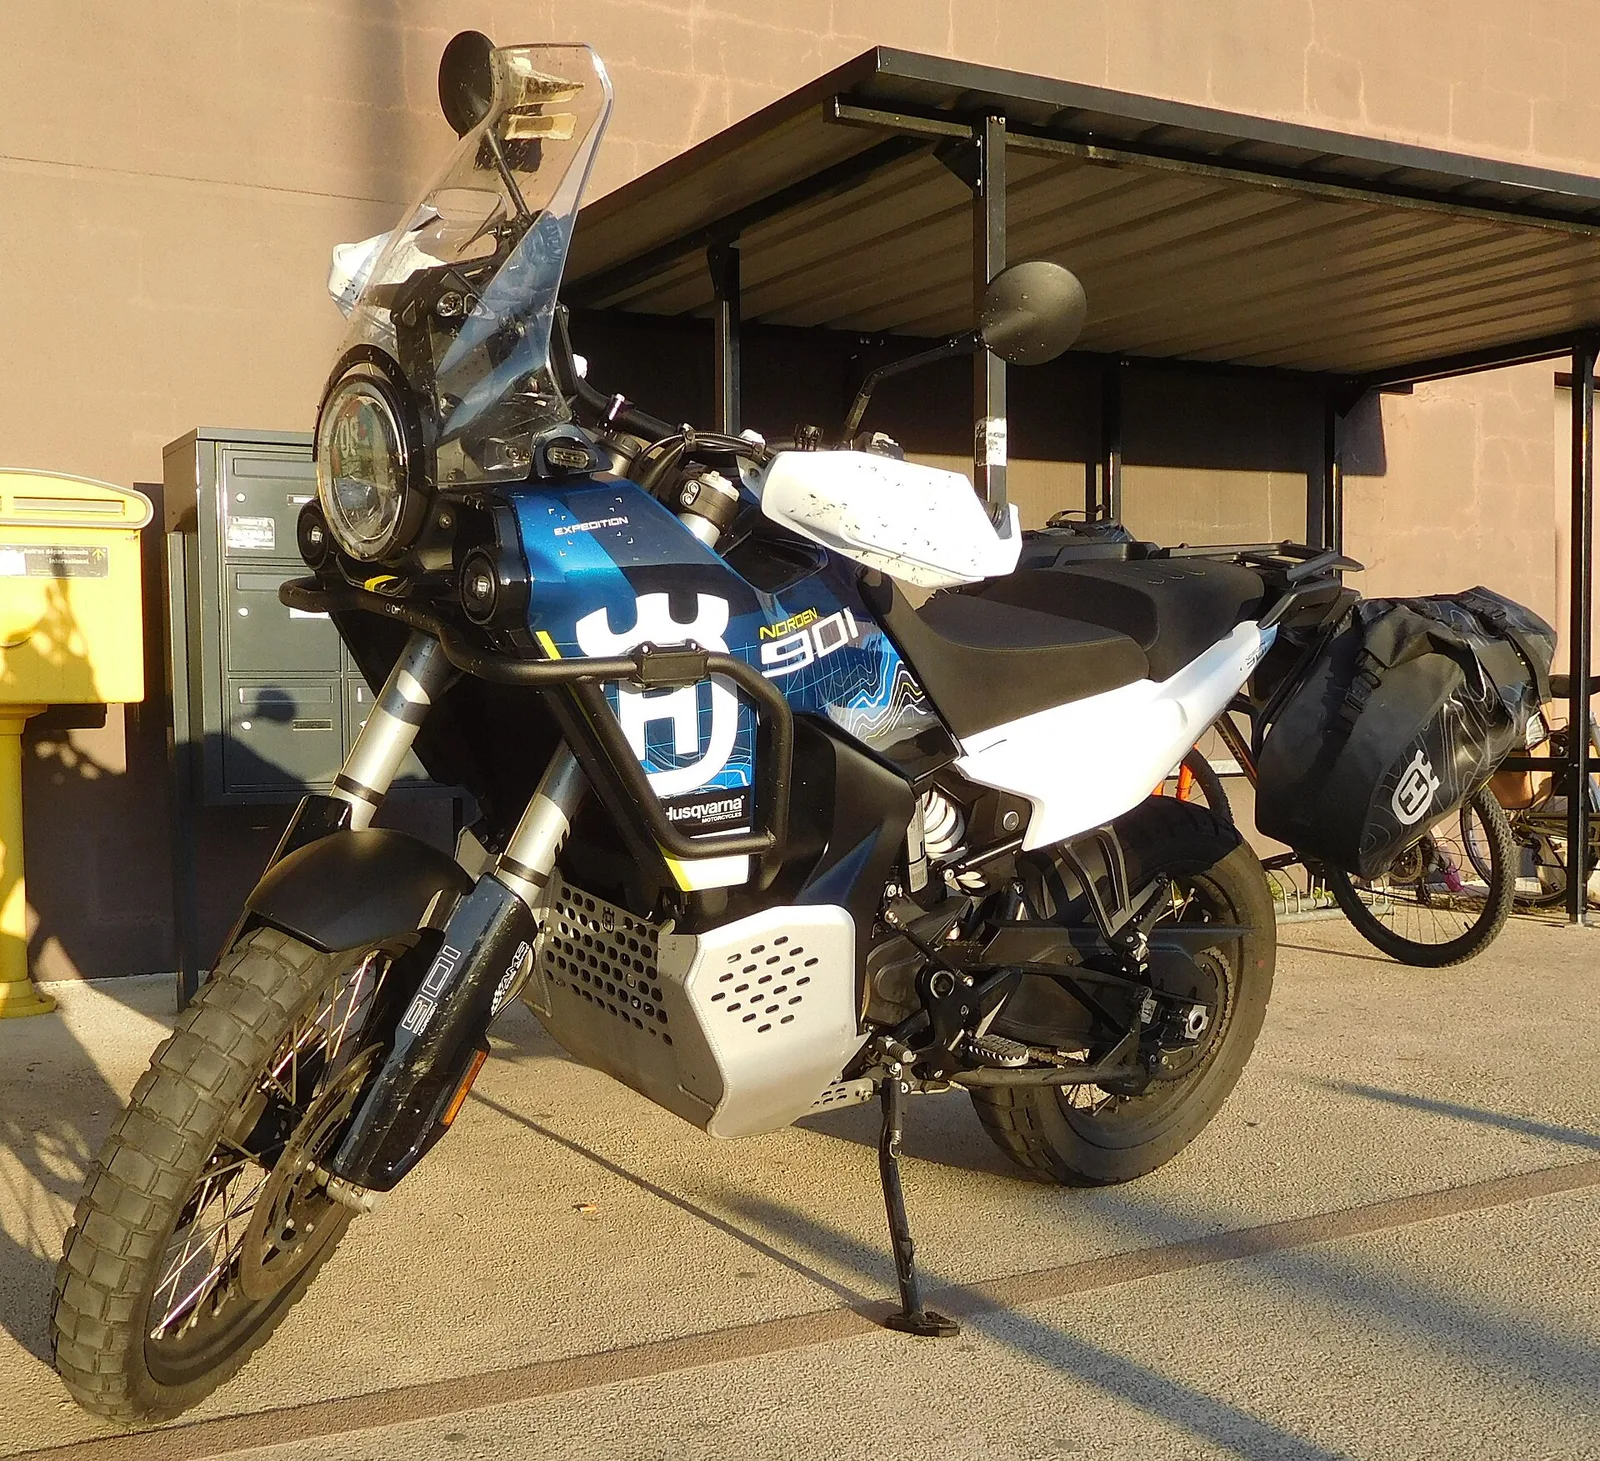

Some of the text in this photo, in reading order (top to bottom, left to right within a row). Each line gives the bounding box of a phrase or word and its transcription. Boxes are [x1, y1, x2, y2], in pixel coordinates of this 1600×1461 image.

[554, 516, 629, 536] EXPEDITION
[759, 606, 818, 640] NORDEN
[760, 606, 859, 679] 901
[701, 811, 743, 824] MOTORCYCLES
